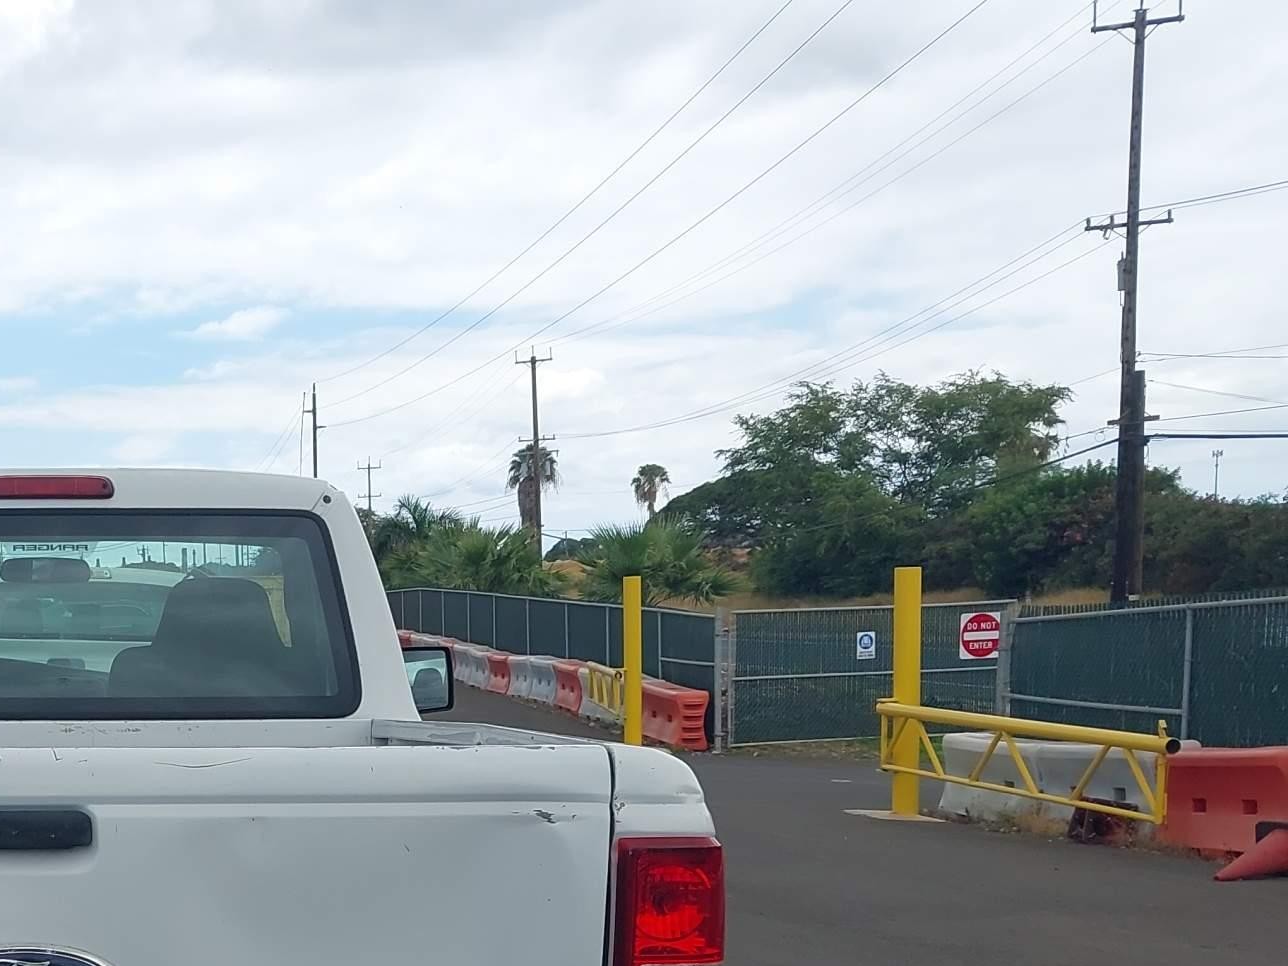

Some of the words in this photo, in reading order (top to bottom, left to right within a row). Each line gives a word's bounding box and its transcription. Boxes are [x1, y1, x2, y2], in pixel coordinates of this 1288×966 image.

[967, 622, 978, 630] DO
[980, 621, 997, 630] NOT
[969, 641, 993, 650] ENTER
